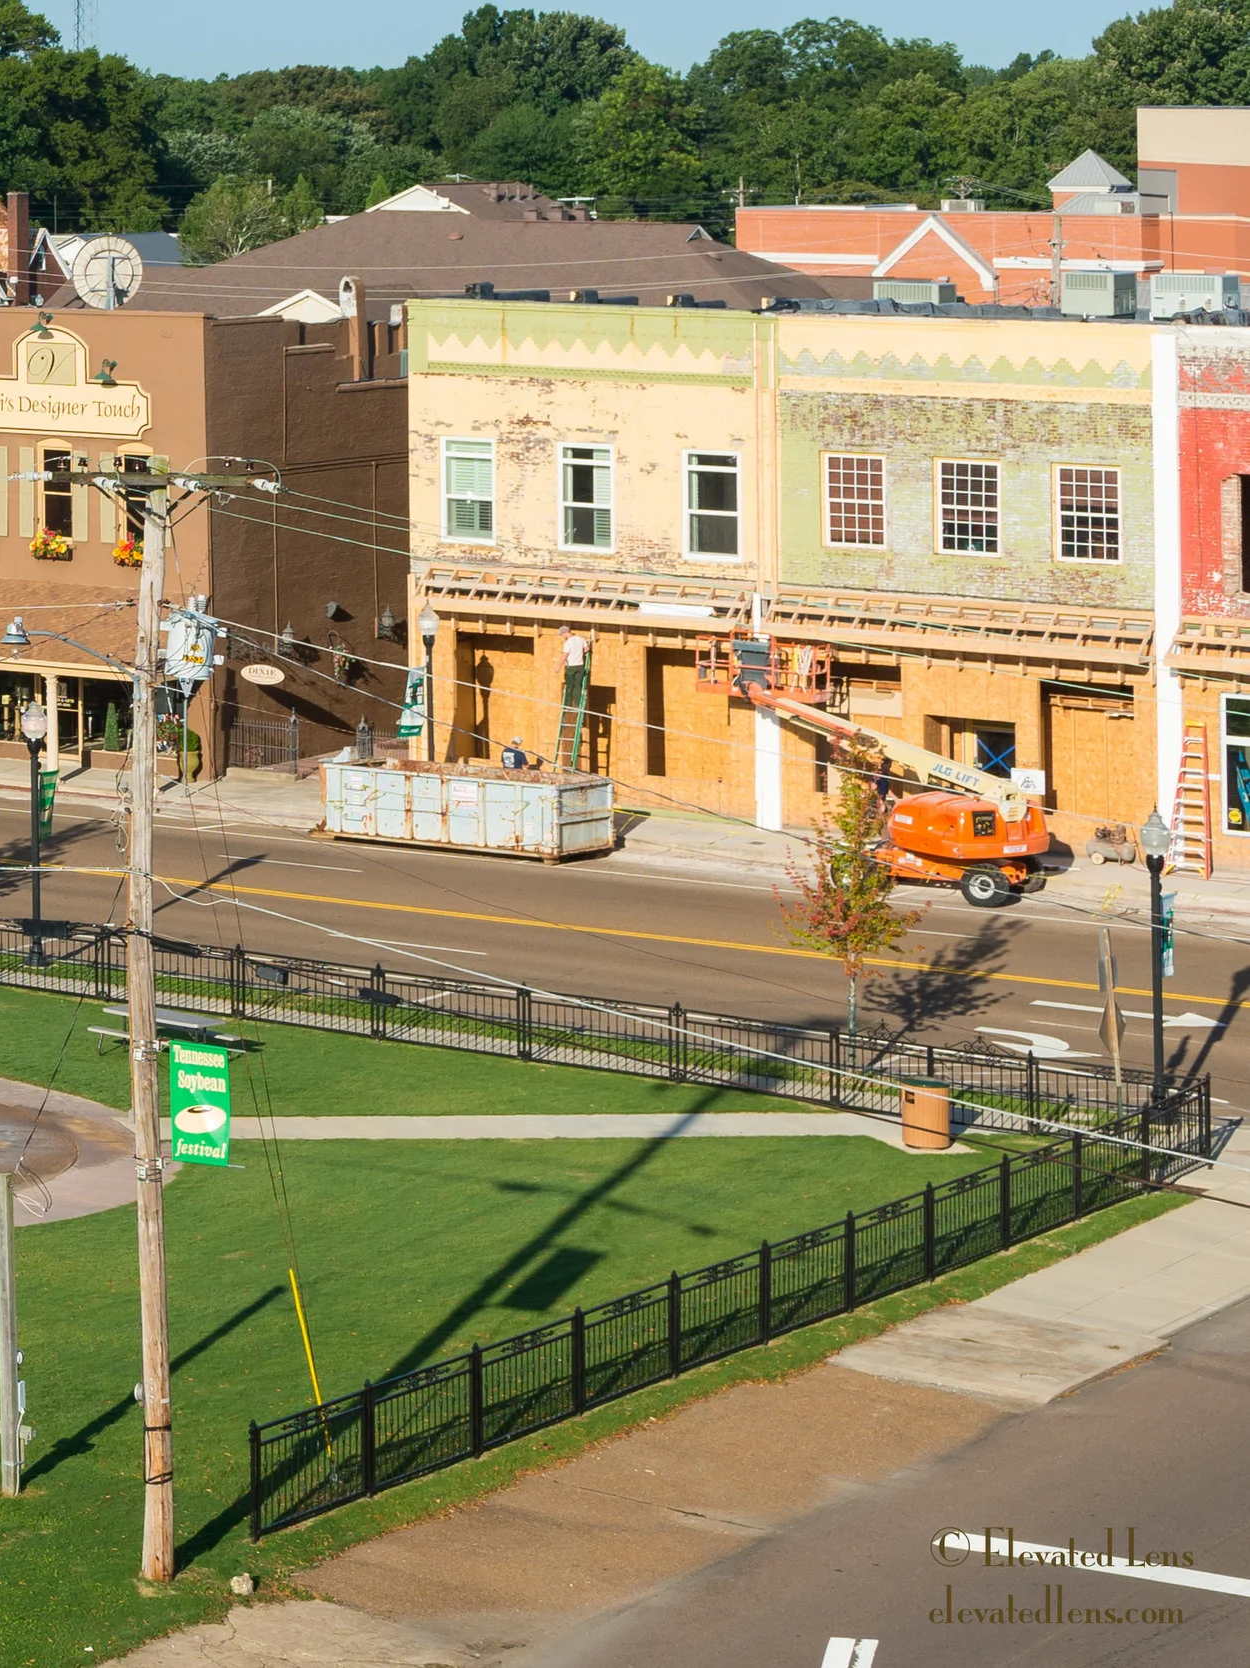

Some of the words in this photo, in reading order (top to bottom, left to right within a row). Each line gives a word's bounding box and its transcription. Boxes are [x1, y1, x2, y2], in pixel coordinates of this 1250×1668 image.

[18, 395, 88, 421] Designer
[92, 394, 141, 421] Touch
[248, 667, 277, 677] DIXIE
[932, 763, 953, 777] JLG
[955, 771, 981, 787] LIFT
[173, 1044, 225, 1068] Tennessee
[177, 1070, 226, 1093] Soybean
[175, 1139, 227, 1159] festival
